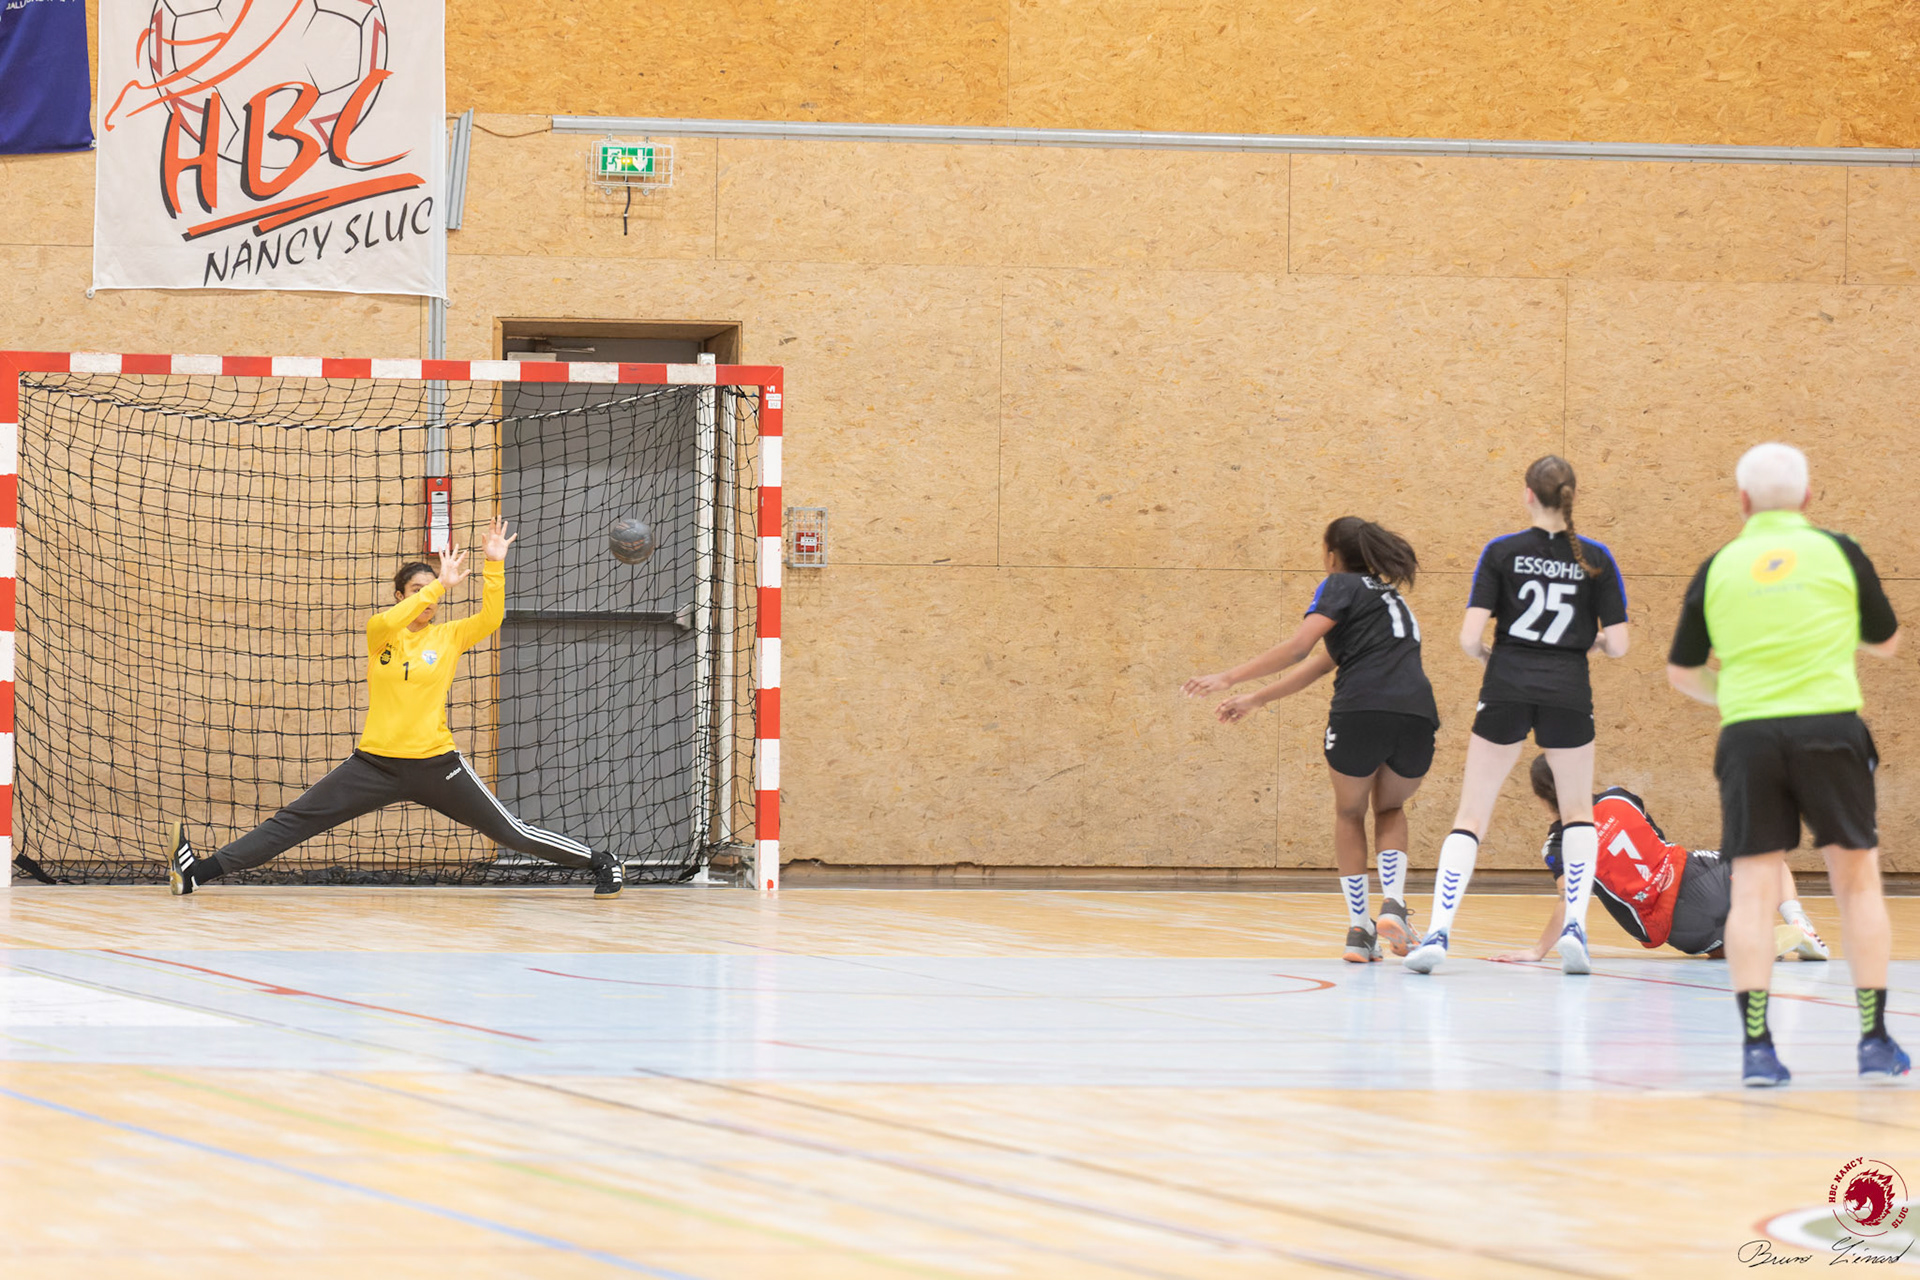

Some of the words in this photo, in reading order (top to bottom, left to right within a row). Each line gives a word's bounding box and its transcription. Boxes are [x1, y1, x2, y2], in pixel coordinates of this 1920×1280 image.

[160, 69, 414, 219] HBC
[203, 221, 333, 287] NANCY
[344, 197, 434, 254] SLUC
[1508, 580, 1577, 644] 25
[402, 661, 410, 681] 1
[1607, 829, 1652, 882] 7
